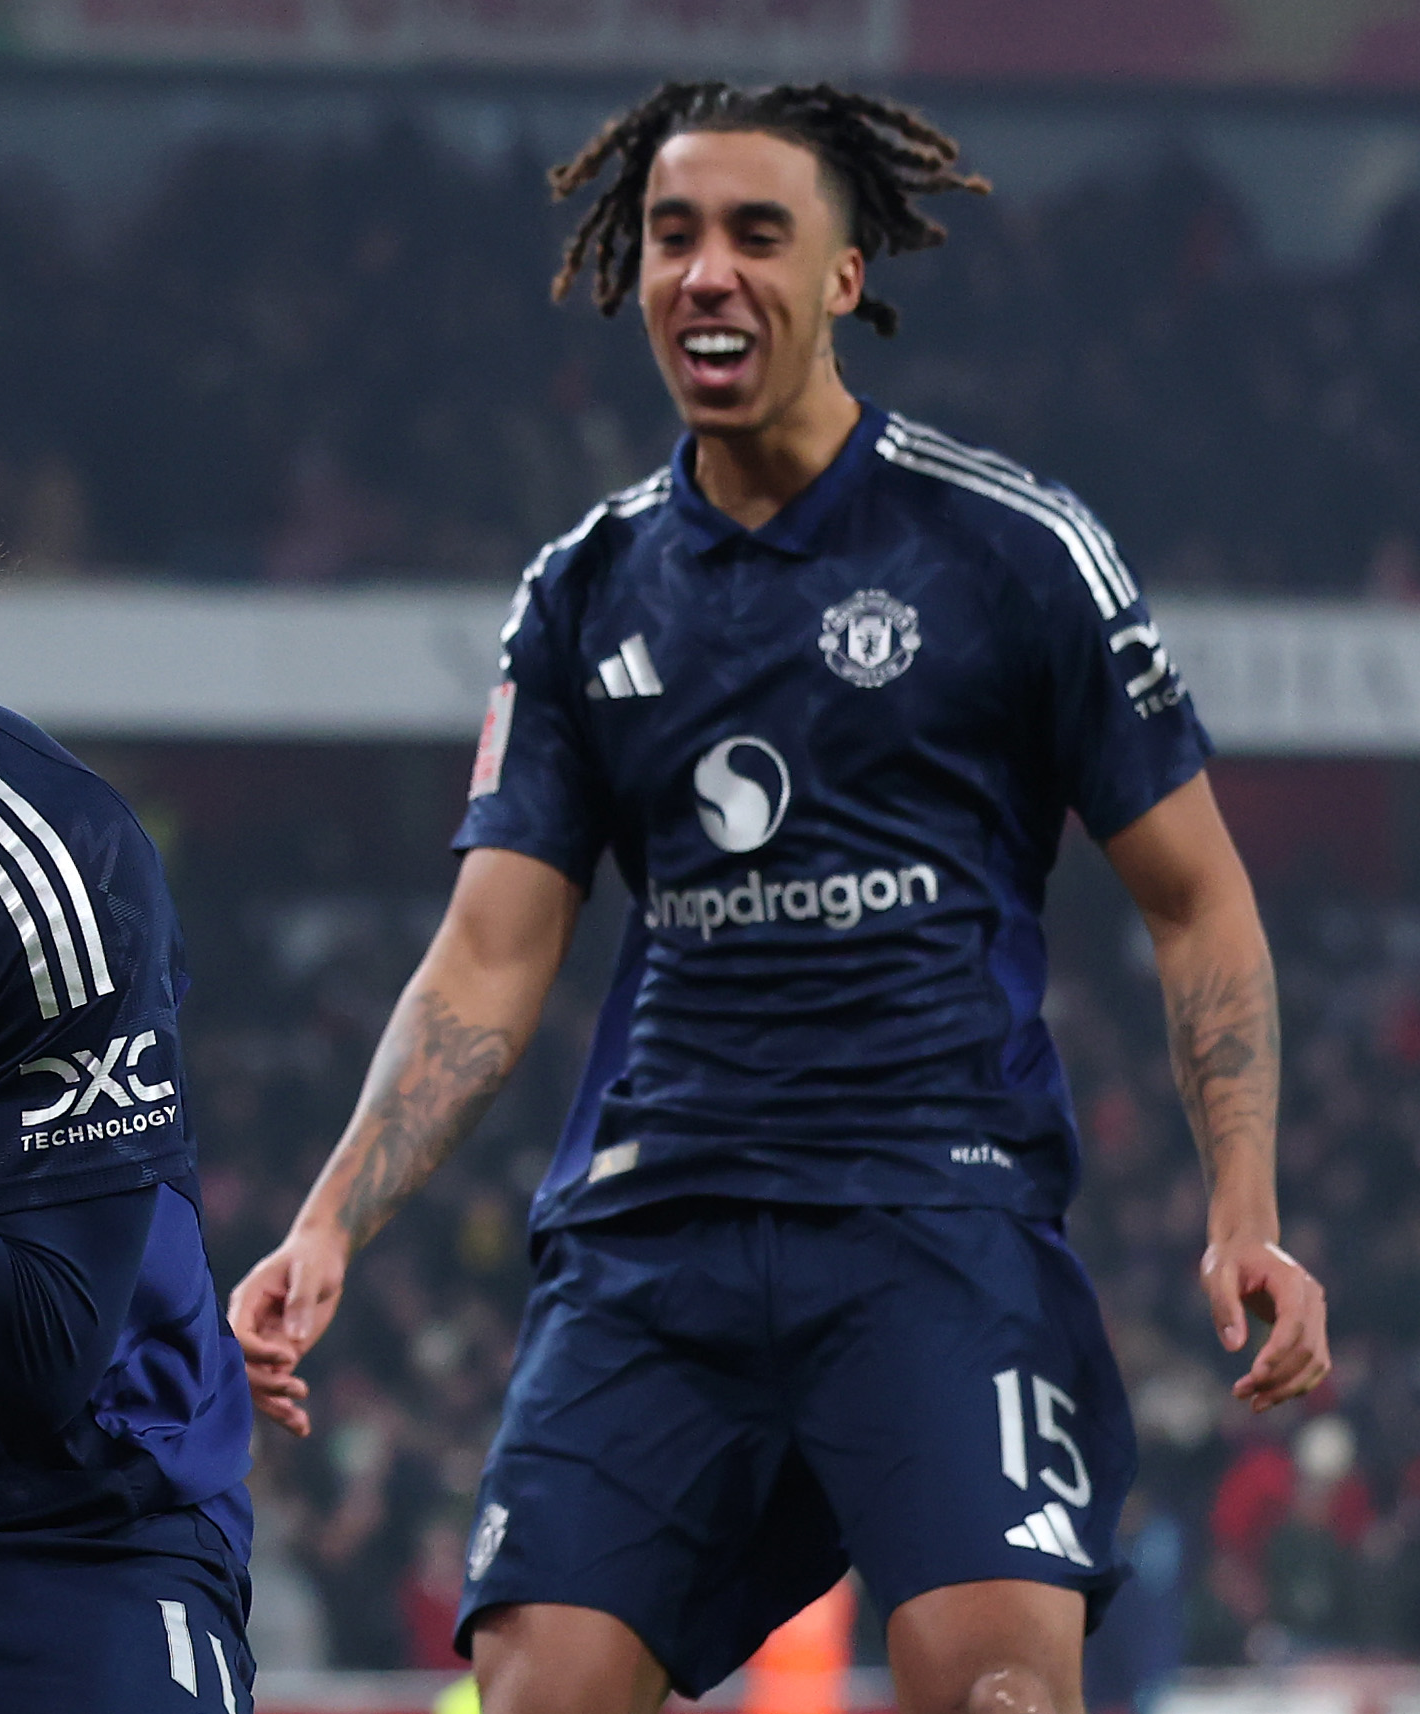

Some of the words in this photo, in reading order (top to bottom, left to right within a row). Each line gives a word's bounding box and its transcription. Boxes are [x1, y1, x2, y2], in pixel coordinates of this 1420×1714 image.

[18, 1029, 176, 1128] DXC
[20, 1104, 177, 1152] TECHNOLOGY
[991, 1367, 1093, 1509] 15
